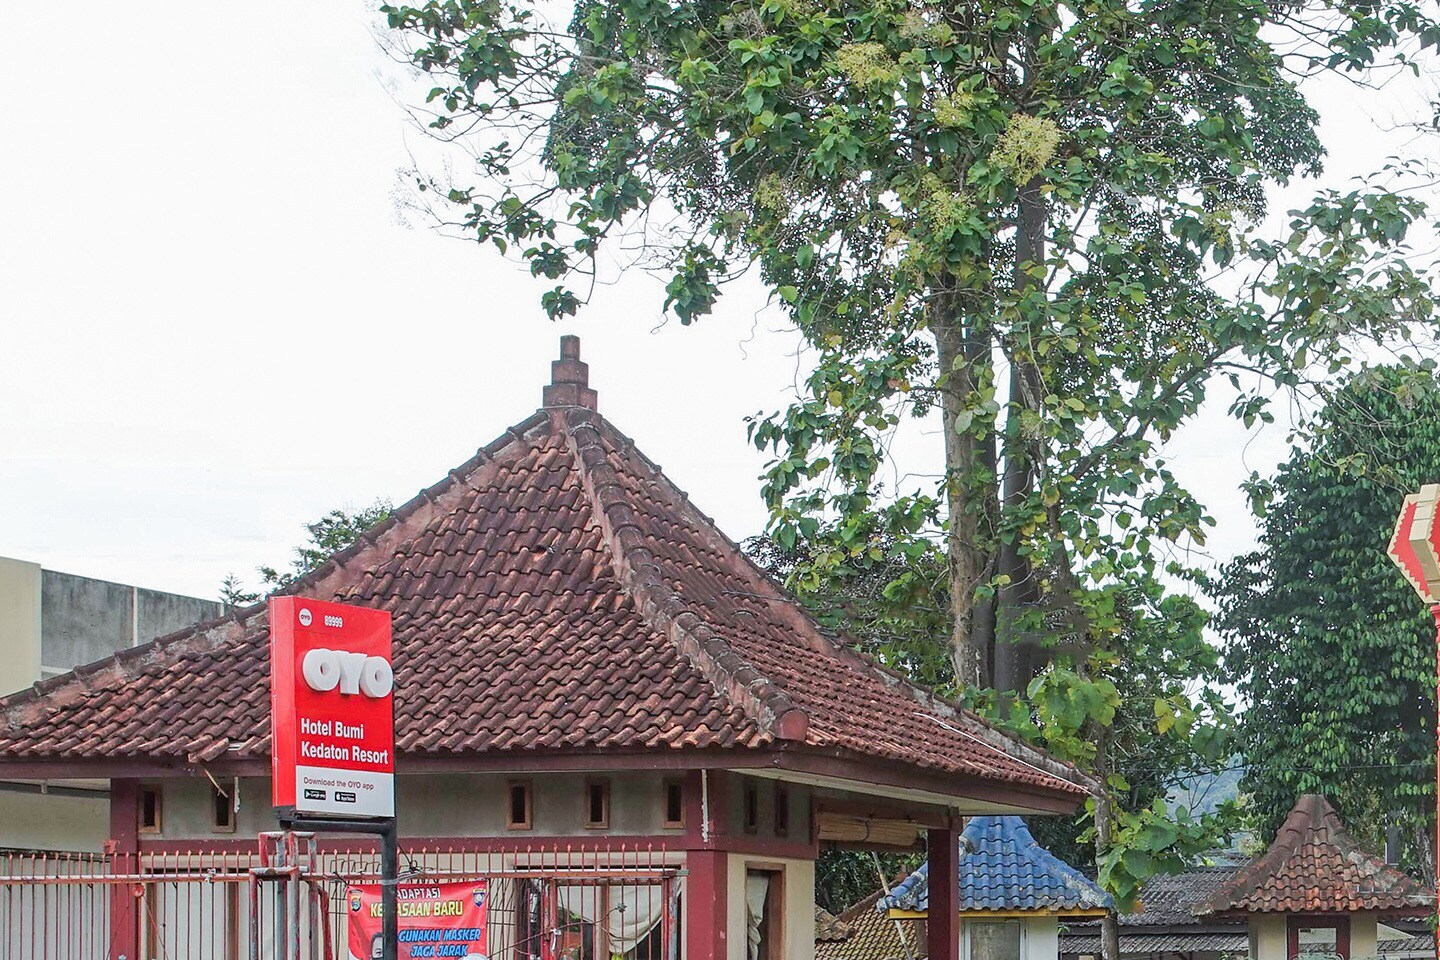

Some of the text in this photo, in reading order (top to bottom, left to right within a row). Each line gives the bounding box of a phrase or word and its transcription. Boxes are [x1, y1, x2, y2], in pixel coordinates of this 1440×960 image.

[302, 648, 394, 699] OYO
[301, 717, 364, 740] Hotel Bumi
[301, 740, 389, 765] Kedaton Resort
[303, 776, 375, 791] Download the OYO app
[433, 900, 464, 917] BARU
[397, 927, 482, 942] GUNAKAN MASKER
[410, 943, 469, 958] JAGA JARAK
